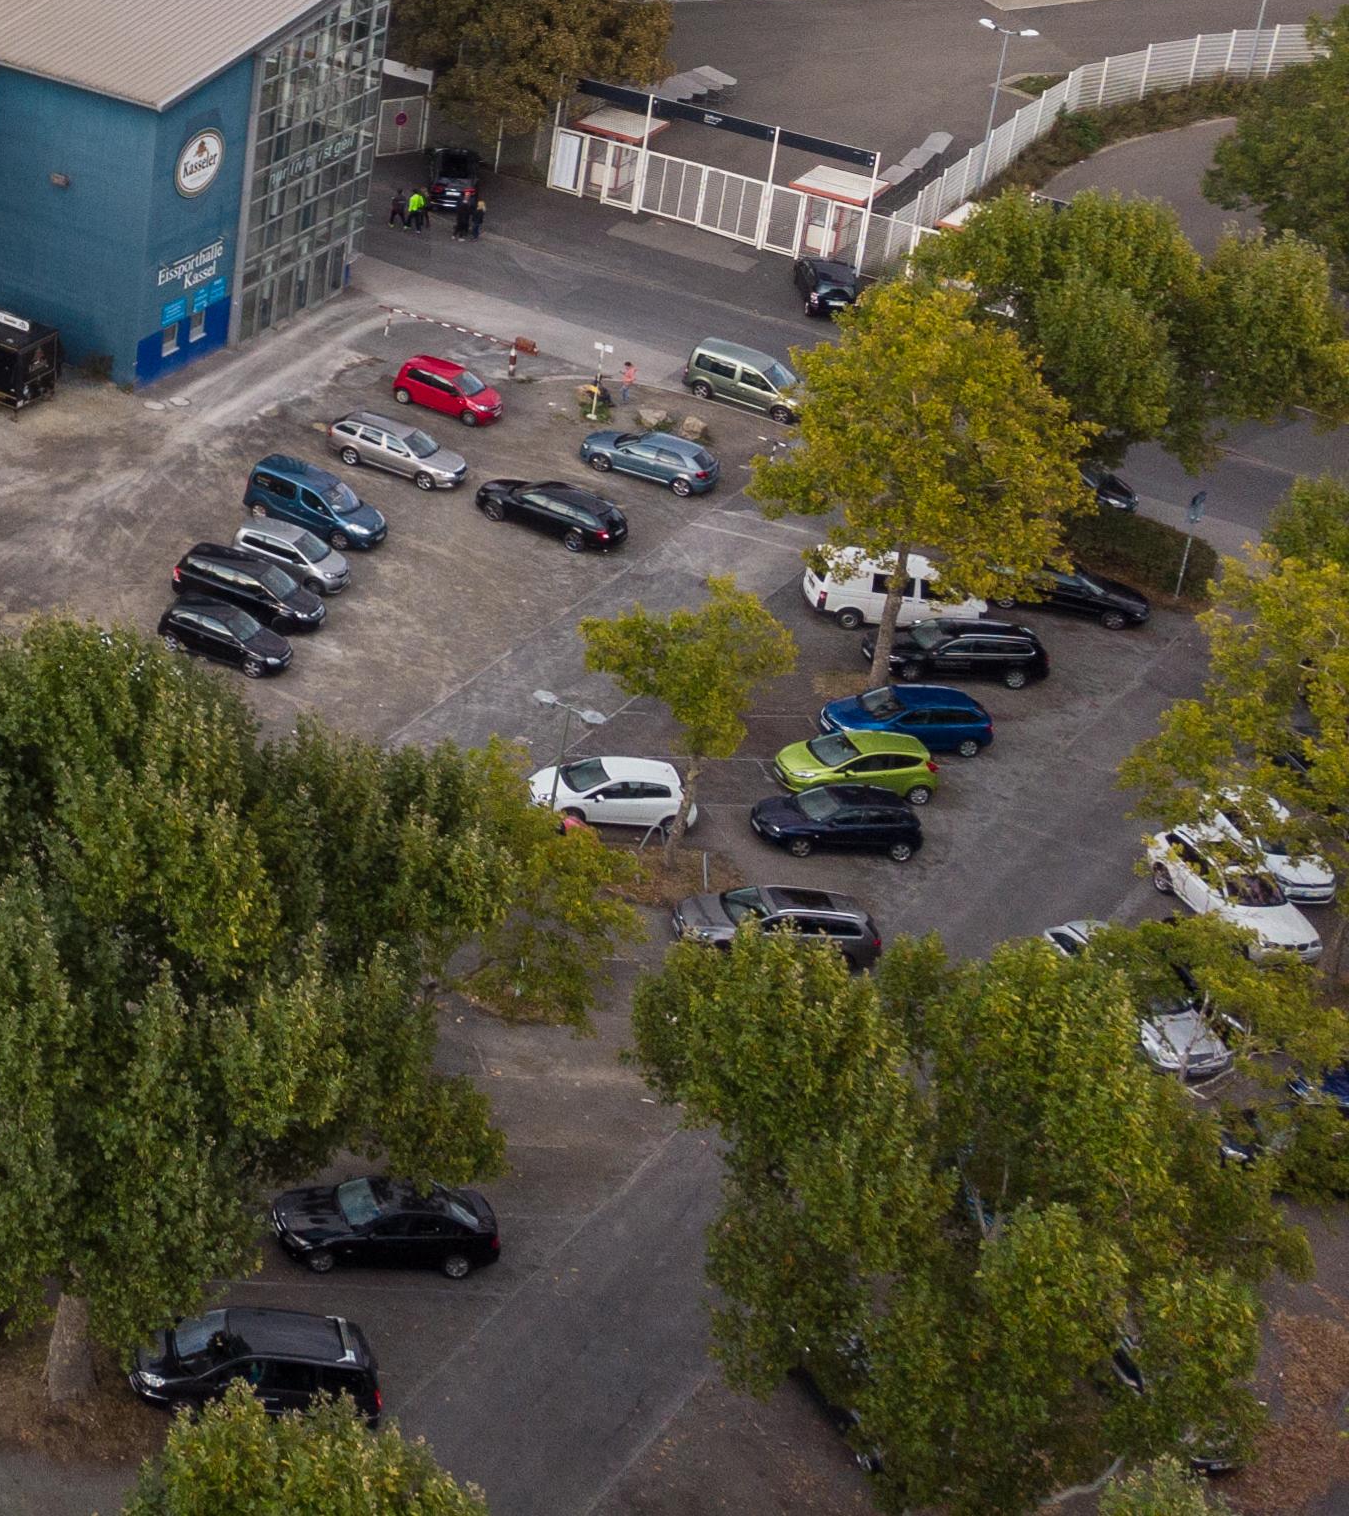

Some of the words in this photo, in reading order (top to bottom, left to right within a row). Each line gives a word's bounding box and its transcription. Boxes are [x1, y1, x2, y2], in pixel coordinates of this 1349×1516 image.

[182, 153, 218, 178] Kasseler
[157, 244, 224, 286] Eissporthalle
[183, 260, 217, 289] Kassel
